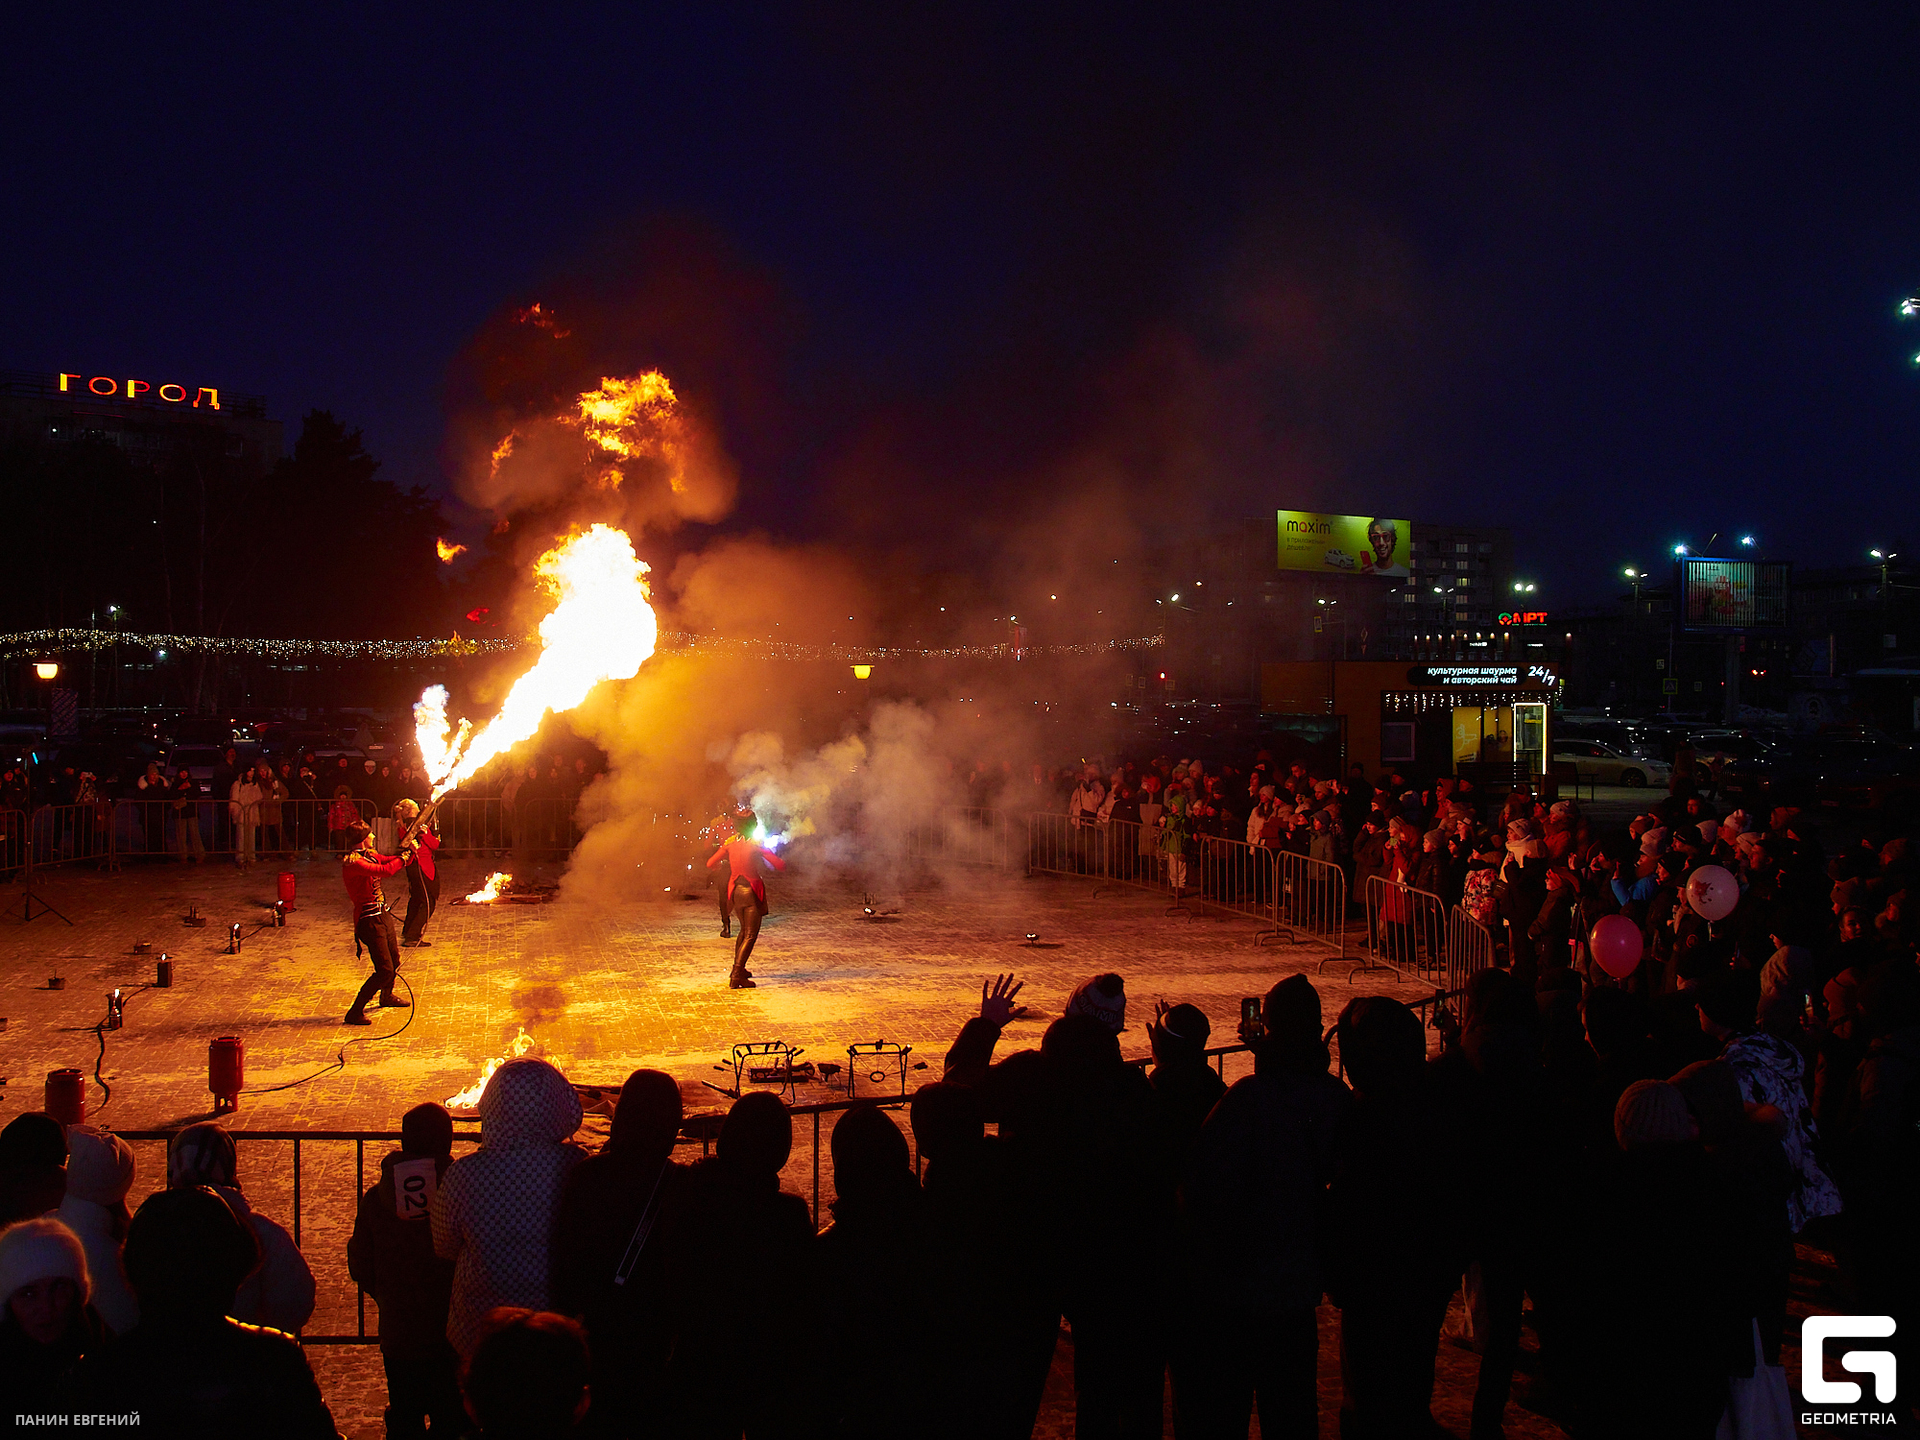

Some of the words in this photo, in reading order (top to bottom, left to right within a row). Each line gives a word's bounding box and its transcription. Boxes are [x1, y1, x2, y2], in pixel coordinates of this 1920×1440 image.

[59, 373, 220, 410] ГОРОД
[1287, 518, 1330, 535] maxim
[1427, 667, 1479, 677] культурная
[1480, 667, 1517, 679] шаурма
[1451, 676, 1498, 686] авторский
[1500, 676, 1517, 684] чай
